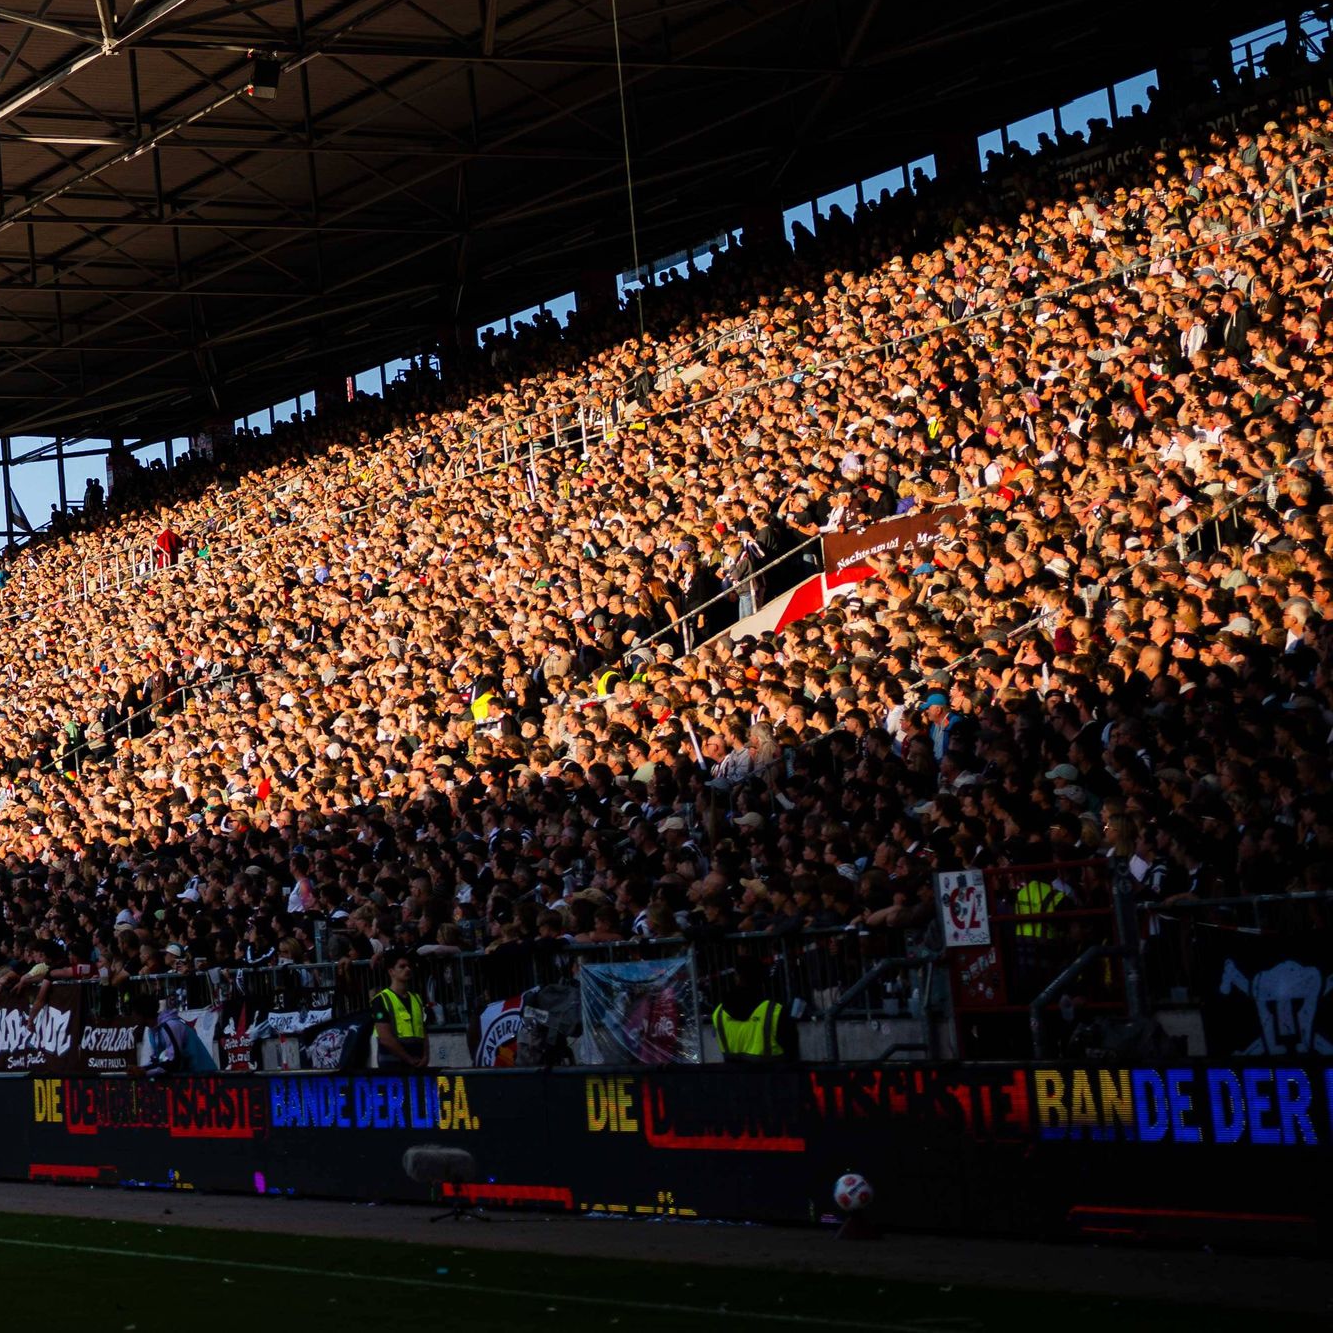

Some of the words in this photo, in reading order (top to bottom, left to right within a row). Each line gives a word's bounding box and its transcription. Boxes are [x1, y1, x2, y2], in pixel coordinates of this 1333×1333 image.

[949, 887, 981, 929] C2
[34, 1079, 63, 1123] DIE
[270, 1075, 351, 1129] BANDE
[354, 1075, 406, 1129] DER
[409, 1075, 481, 1131] LIGA.
[585, 1074, 639, 1133] DIE
[1033, 1067, 1205, 1145] BANDE
[1206, 1067, 1320, 1146] DER
